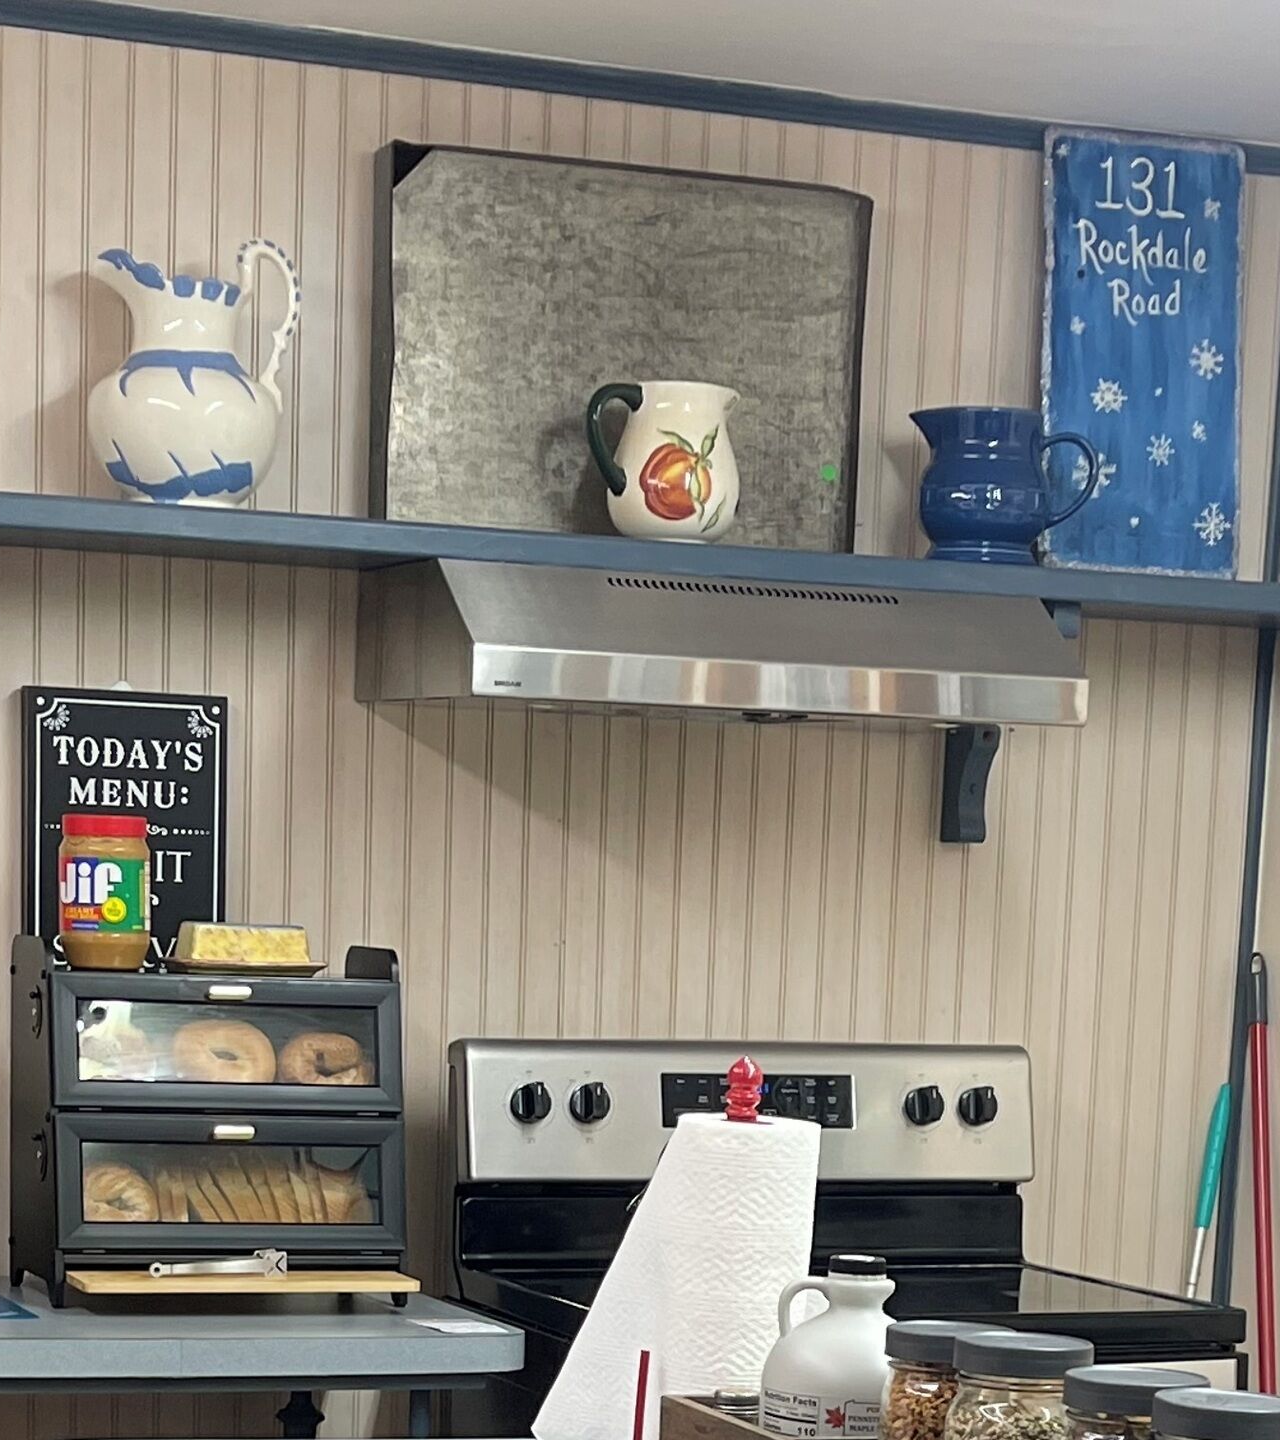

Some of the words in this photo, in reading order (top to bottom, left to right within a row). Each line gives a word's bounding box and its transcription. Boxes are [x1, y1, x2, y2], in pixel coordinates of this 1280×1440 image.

[1095, 155, 1186, 219] 131
[1073, 217, 1208, 286] Rockdale
[1107, 277, 1181, 327] Road
[53, 734, 204, 773] TODAY'S
[68, 776, 190, 809] MENU:
[60, 861, 122, 905] Jif
[155, 850, 192, 884] IT
[793, 1396, 817, 1407] Facts
[797, 1427, 816, 1437] 110
